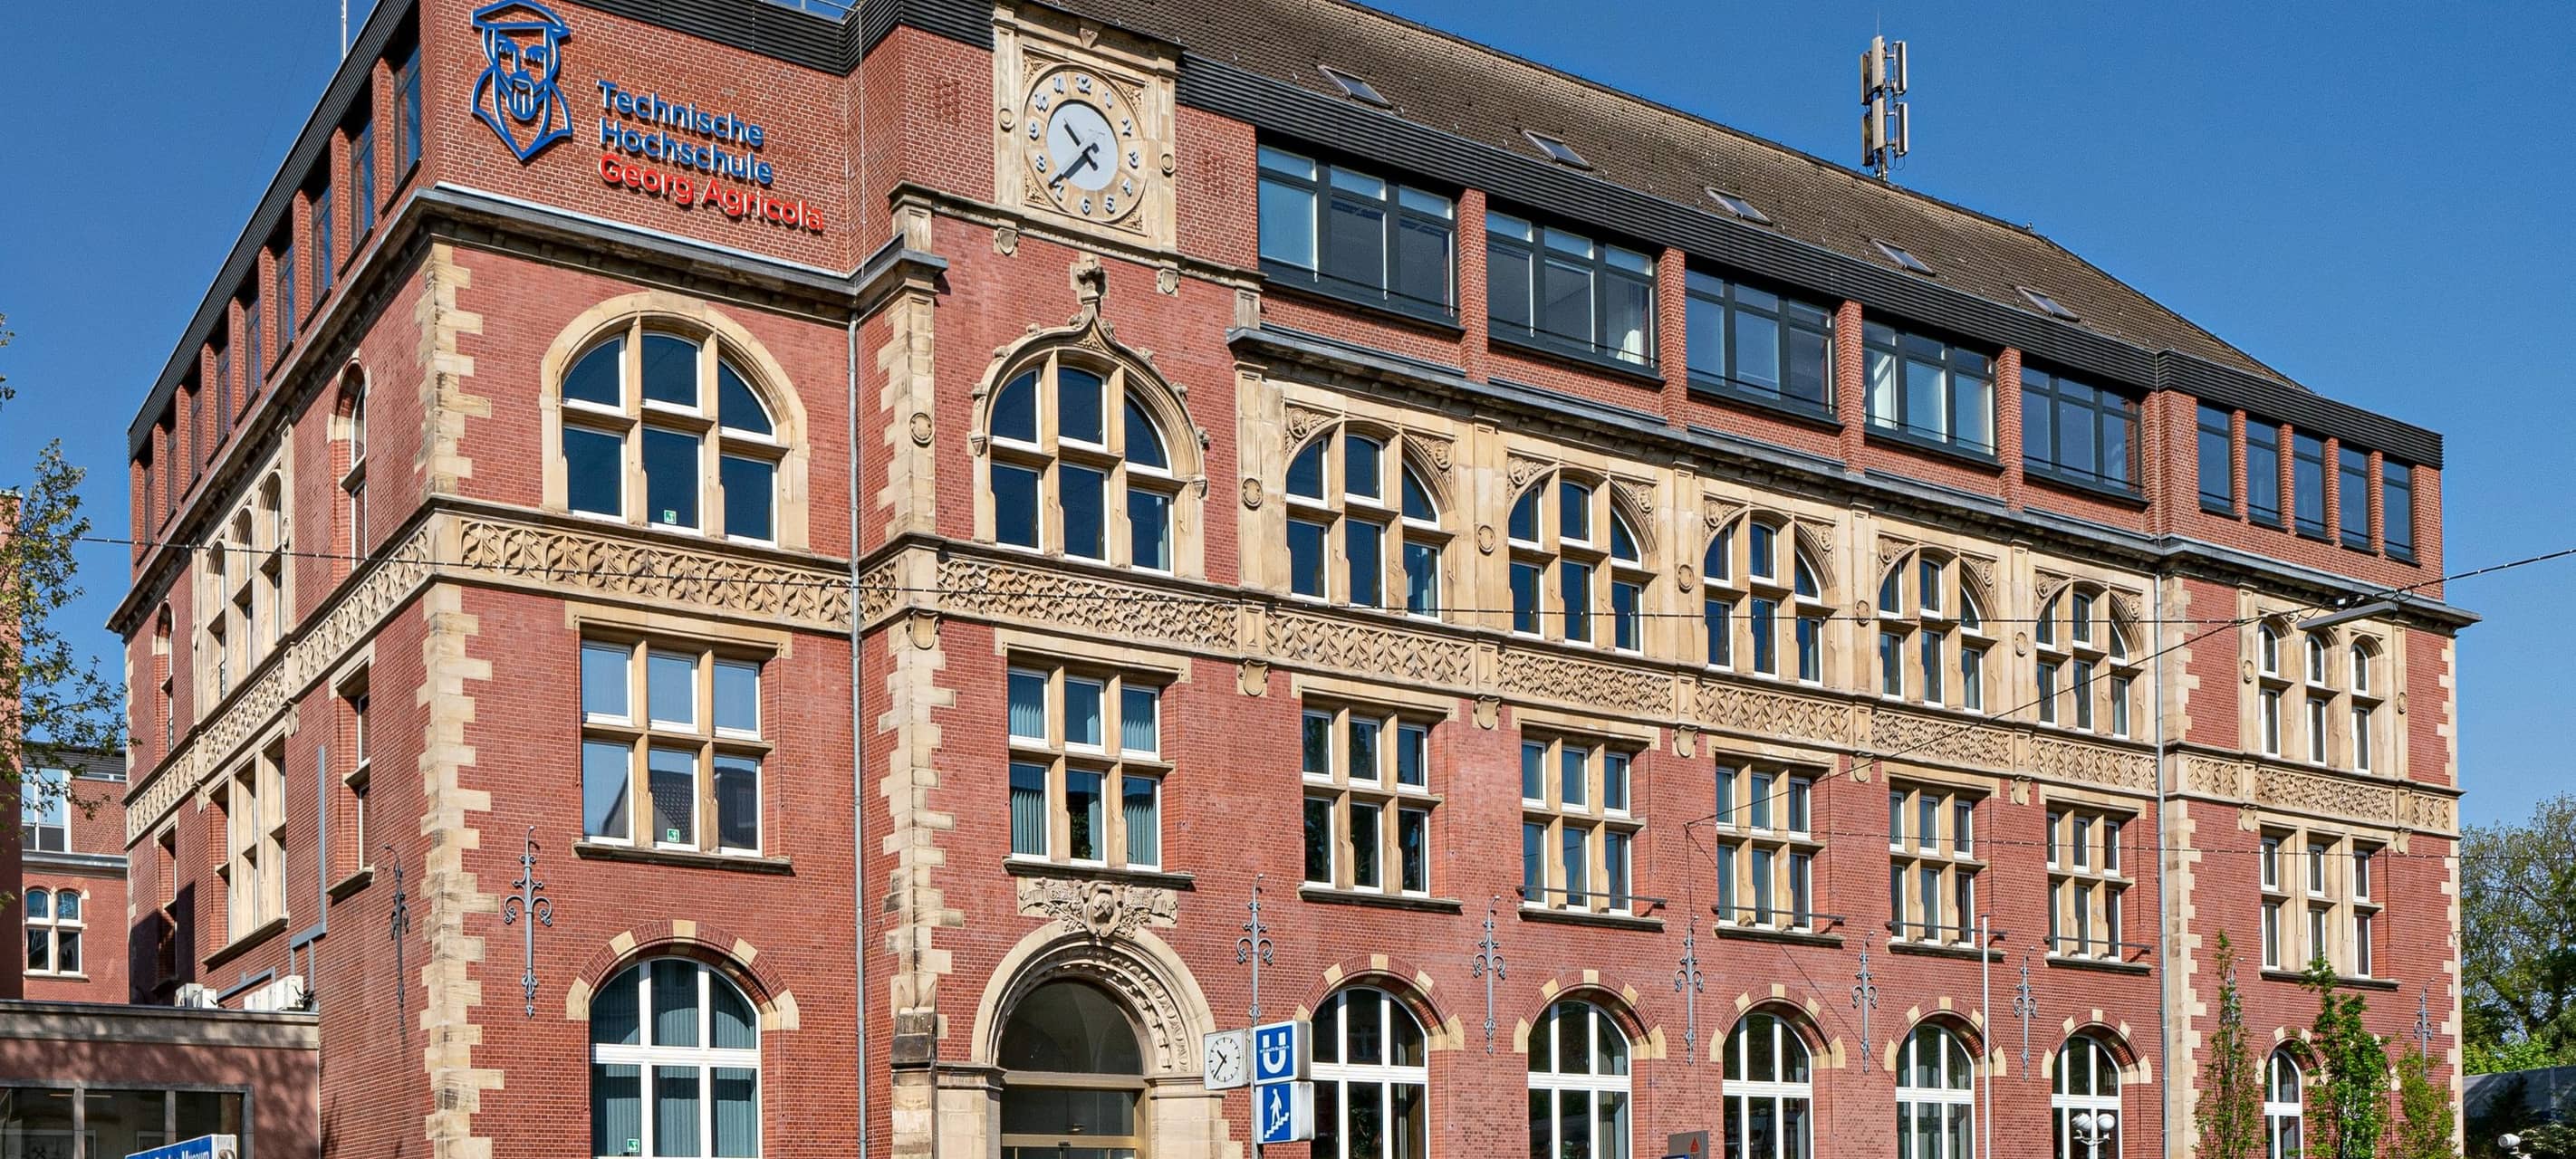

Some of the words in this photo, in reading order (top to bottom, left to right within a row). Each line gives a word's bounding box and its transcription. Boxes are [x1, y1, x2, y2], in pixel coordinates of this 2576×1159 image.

[1053, 75, 1064, 94] 11
[1076, 74, 1091, 95] 12
[1034, 91, 1049, 112] 10
[1105, 91, 1114, 109] 1
[597, 80, 764, 147] Technische
[1029, 121, 1040, 140] 9
[1121, 118, 1132, 137] 2
[599, 117, 774, 185] Hochschule
[1129, 149, 1139, 168] 3
[1035, 152, 1046, 173] 8
[598, 153, 694, 206] Georg
[701, 179, 823, 232] Agricola
[1053, 181, 1064, 201] 7
[1122, 177, 1132, 196] 4
[1081, 196, 1091, 215] 6
[1104, 195, 1116, 214] 5
[1263, 1032, 1286, 1074] U
